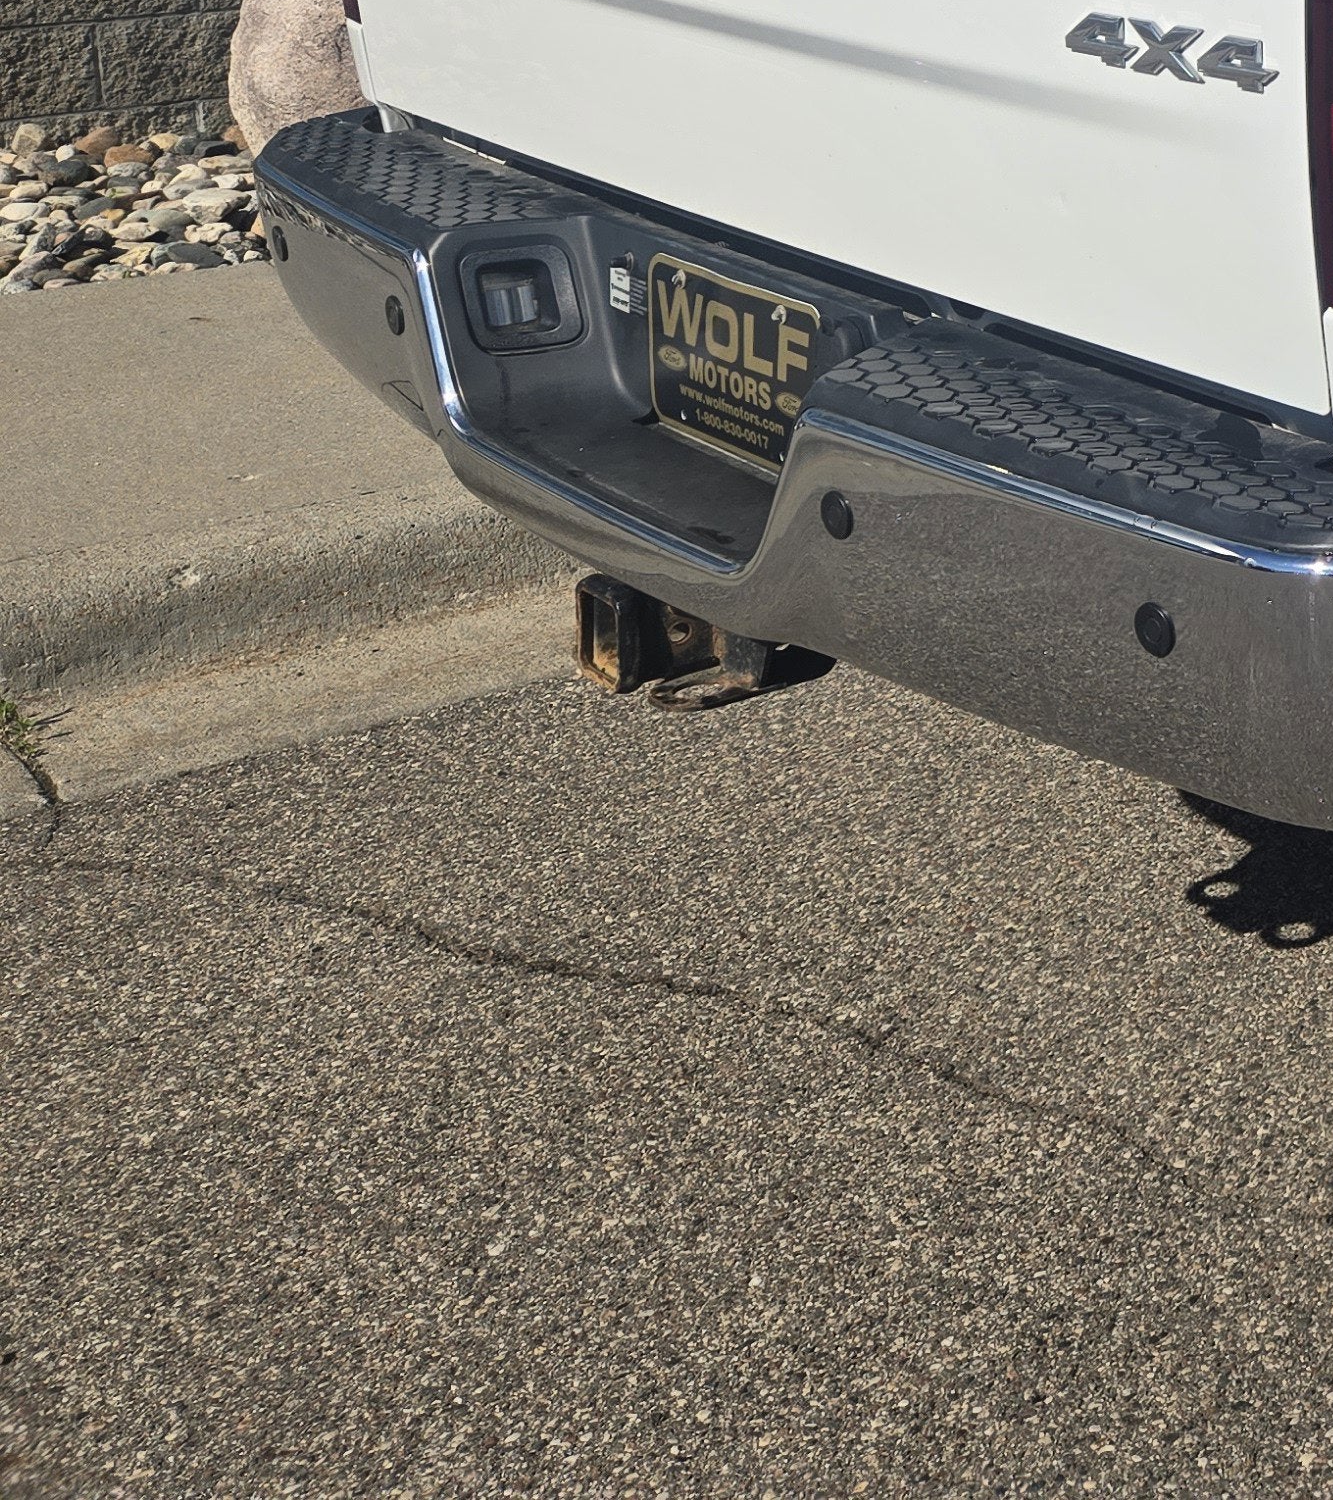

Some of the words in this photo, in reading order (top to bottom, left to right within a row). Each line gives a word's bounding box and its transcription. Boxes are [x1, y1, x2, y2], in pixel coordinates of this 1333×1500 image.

[1065, 11, 1280, 95] 4X4
[657, 279, 810, 383] WOLF
[679, 383, 785, 437] www.wolfmotors.com
[689, 353, 772, 411] MOTORS
[695, 408, 769, 449] 1-800-830-0017
